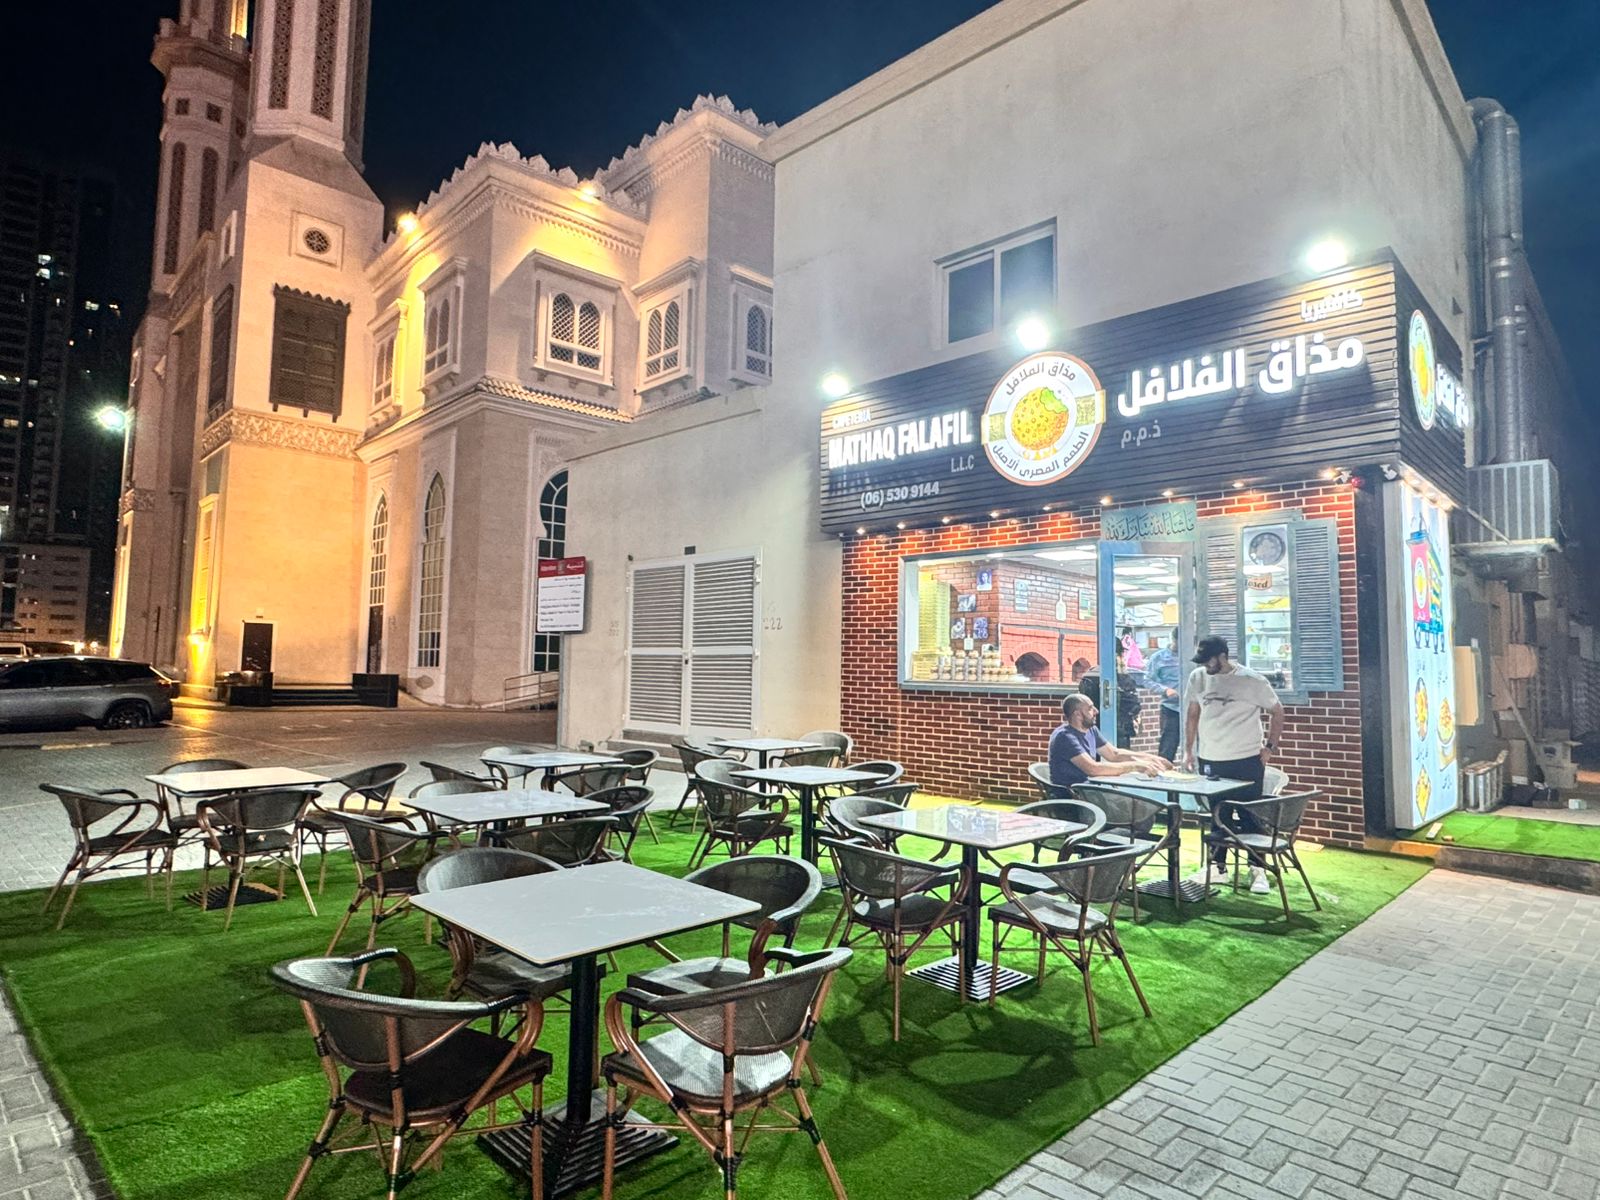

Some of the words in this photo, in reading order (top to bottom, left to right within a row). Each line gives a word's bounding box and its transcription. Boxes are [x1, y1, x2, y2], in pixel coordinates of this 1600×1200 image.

[1006, 362, 1045, 395] الفلافل
[1048, 362, 1076, 381] مذاق
[1258, 332, 1364, 394] مذاق
[1117, 348, 1246, 417] الفلافل
[828, 426, 896, 470] MATHAQ
[898, 411, 972, 456] FALAFIL
[1063, 431, 1089, 467] الطعم
[951, 455, 974, 473] L.L.C
[860, 490, 884, 511] (06)
[887, 487, 909, 502] 530
[911, 481, 940, 498] 9144
